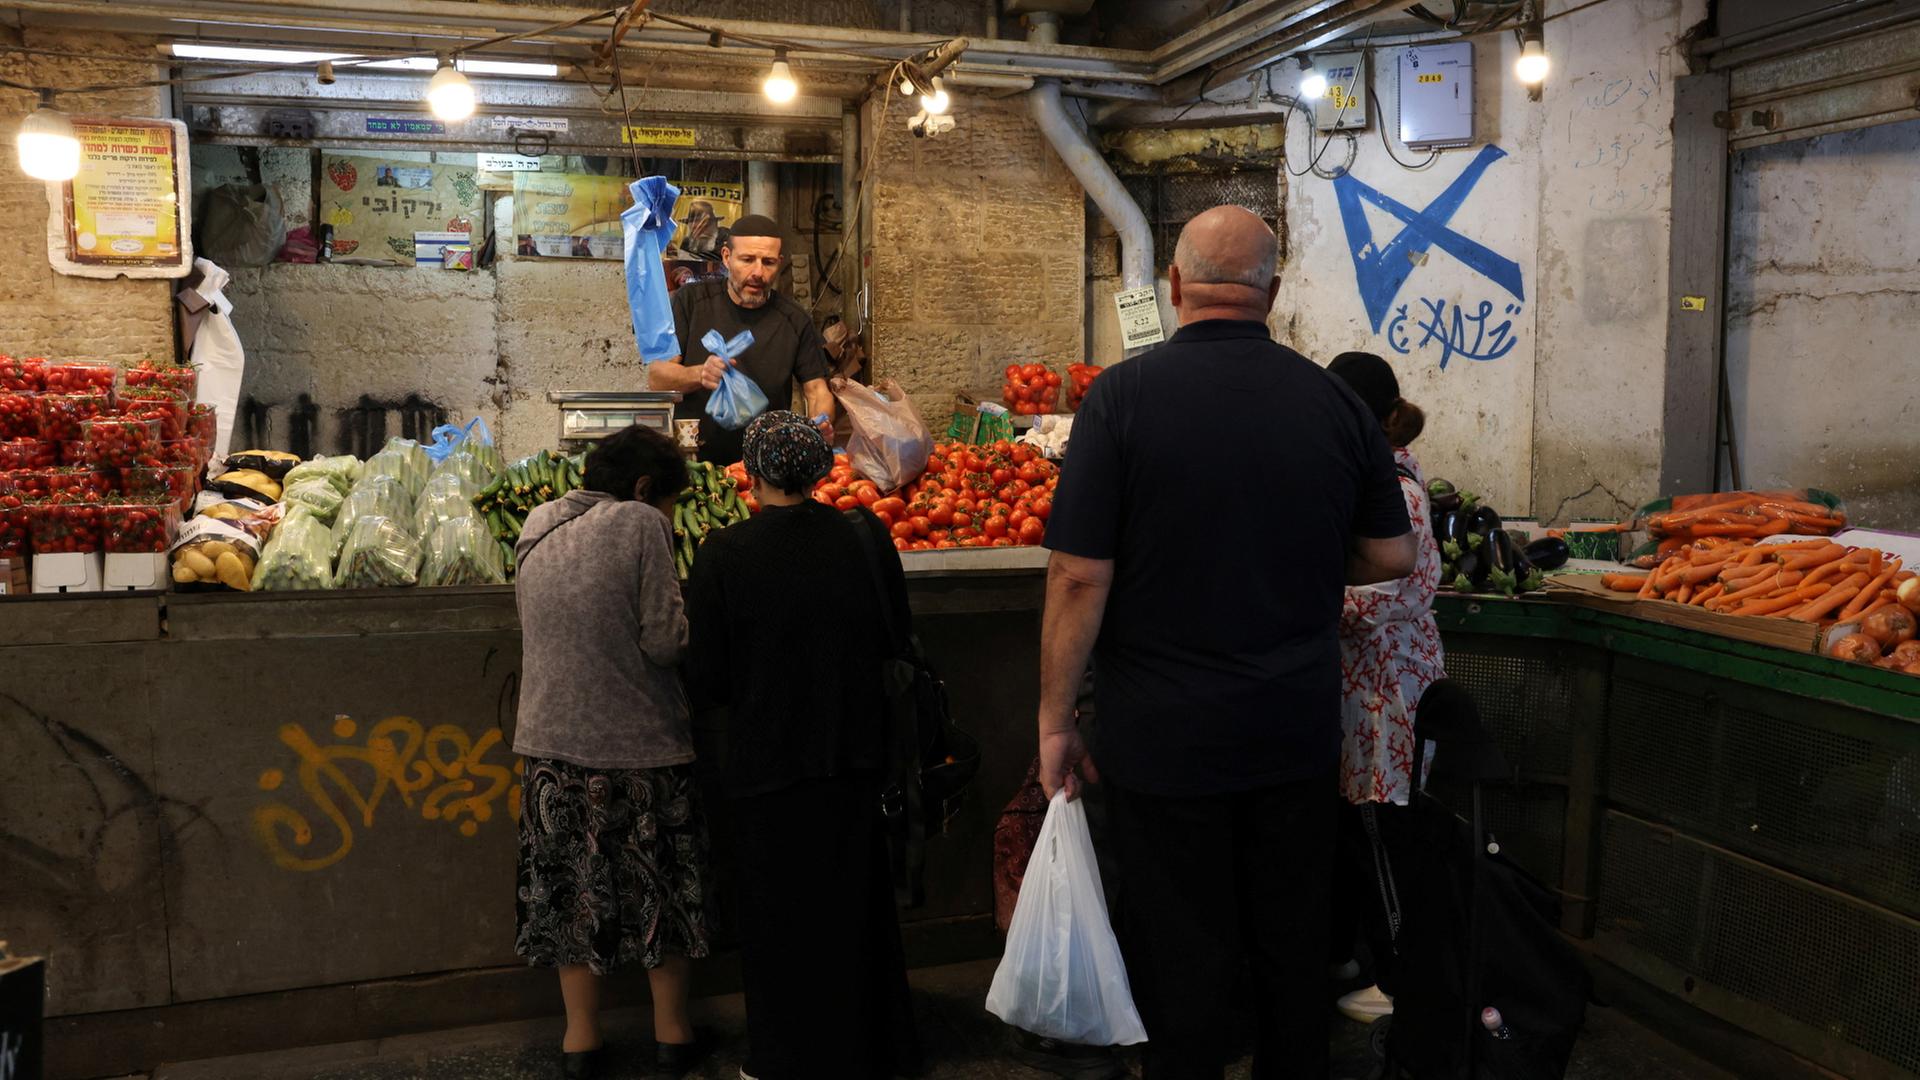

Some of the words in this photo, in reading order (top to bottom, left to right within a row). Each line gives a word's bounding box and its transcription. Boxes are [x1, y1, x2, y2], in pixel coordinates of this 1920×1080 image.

[367, 121, 387, 129] מפחד
[390, 120, 401, 130] לא
[404, 122, 432, 131] שמאמין
[111, 144, 138, 154] כשרות
[527, 161, 539, 169] רק
[711, 187, 741, 201] ברכה
